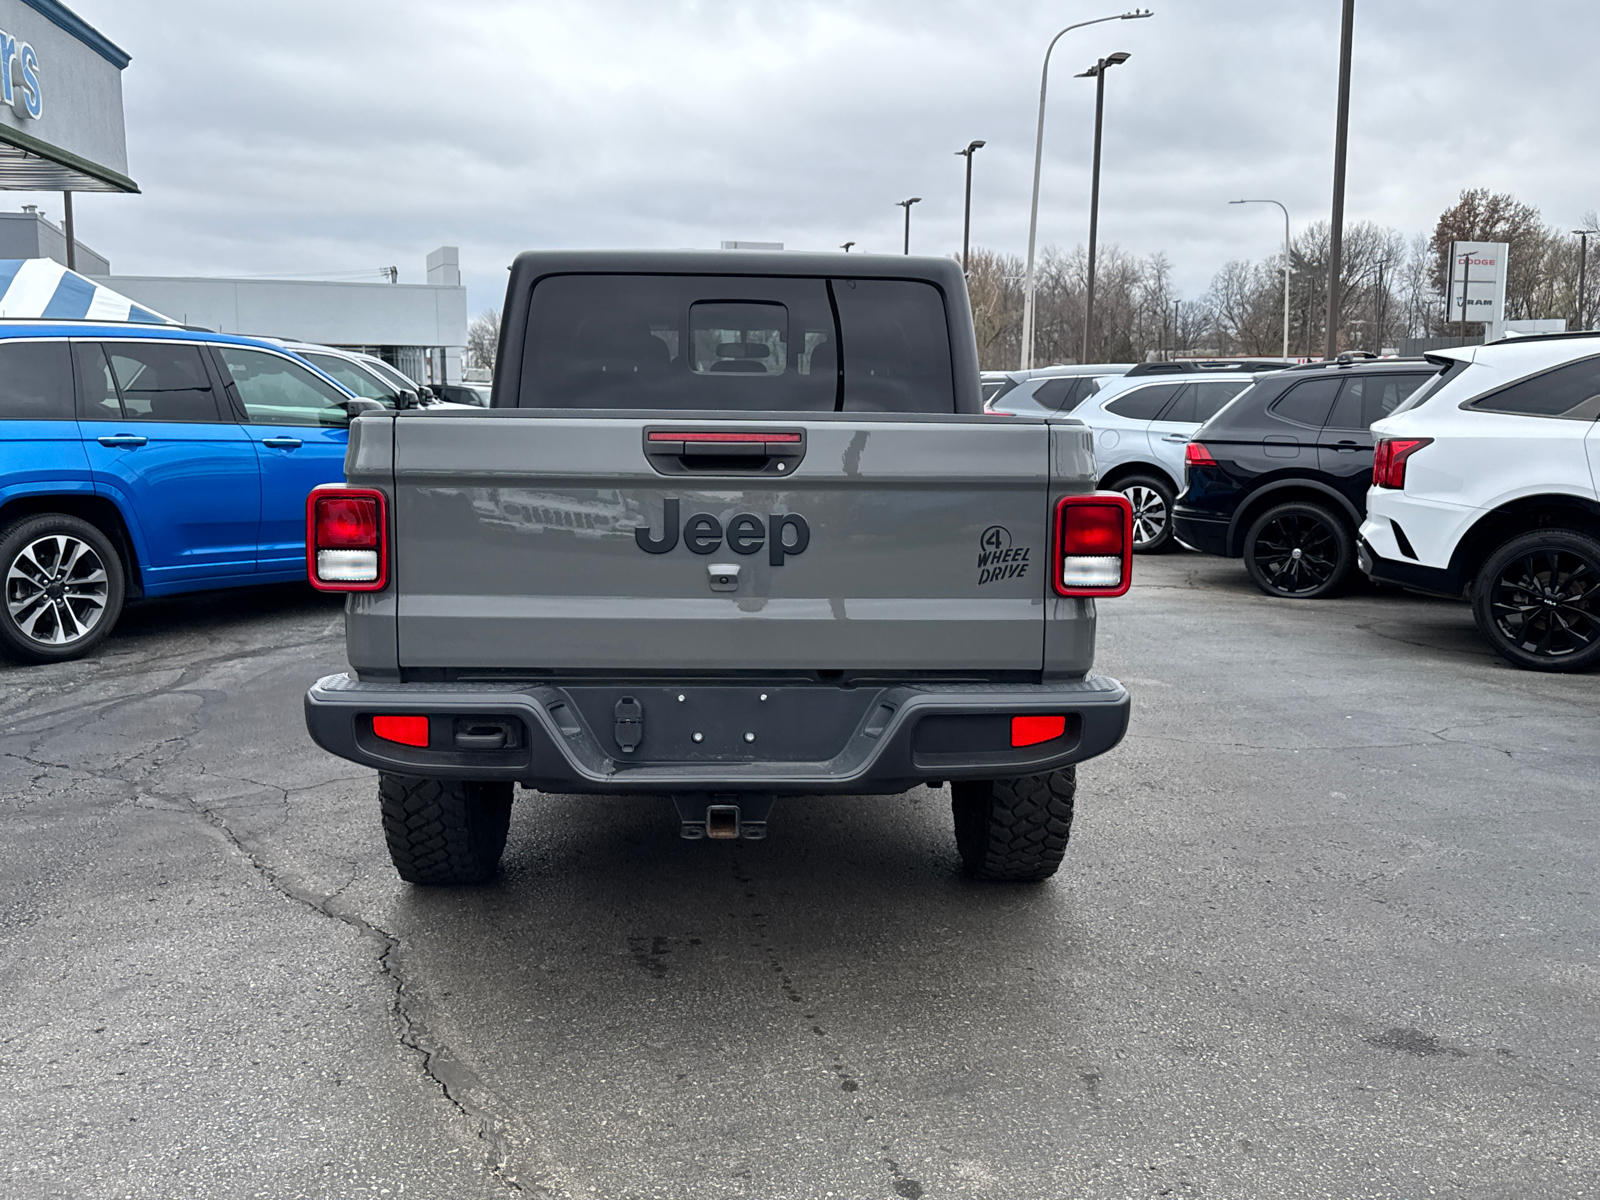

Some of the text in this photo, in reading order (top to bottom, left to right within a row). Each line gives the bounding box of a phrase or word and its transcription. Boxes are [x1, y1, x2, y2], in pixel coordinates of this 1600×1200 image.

[635, 497, 810, 566] Jeep
[985, 529, 1002, 549] 4
[977, 547, 1031, 568] WHEEL
[977, 563, 1030, 586] DRIVE
